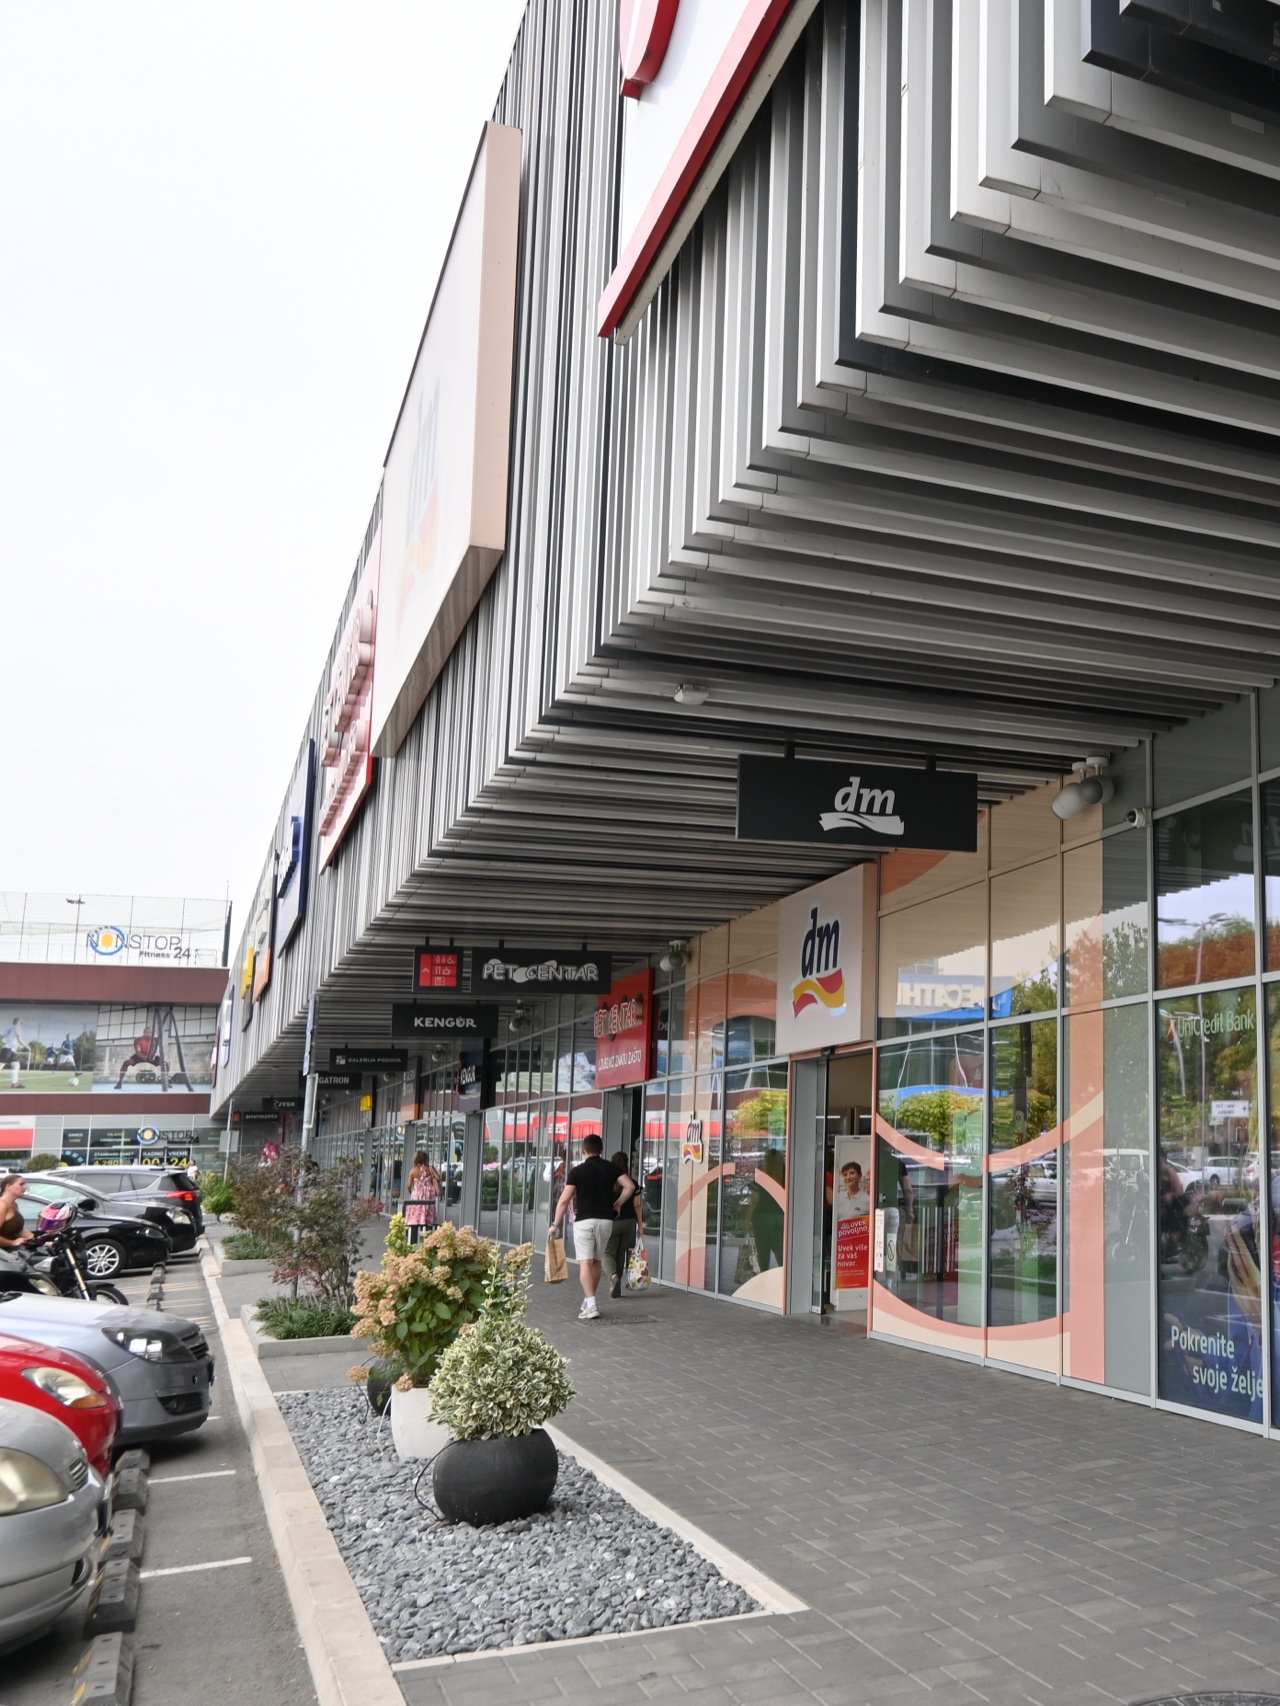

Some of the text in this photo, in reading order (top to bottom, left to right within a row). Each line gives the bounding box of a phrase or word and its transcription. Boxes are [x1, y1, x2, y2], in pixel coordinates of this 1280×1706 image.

[834, 776, 896, 815] dm
[86, 931, 181, 951] NONSTOP
[139, 946, 192, 959] Fitness 24
[801, 906, 841, 979] dm
[482, 964, 600, 981] PET CENTAR
[593, 998, 637, 1038] PET CENTAR
[1177, 1008, 1255, 1038] UniCredit Bank
[686, 1113, 700, 1144] dm
[849, 1219, 867, 1228] uvek
[837, 1243, 868, 1252] Uvek više
[1170, 1325, 1235, 1360] Pokrenite
[1192, 1363, 1264, 1402] svoje želje
